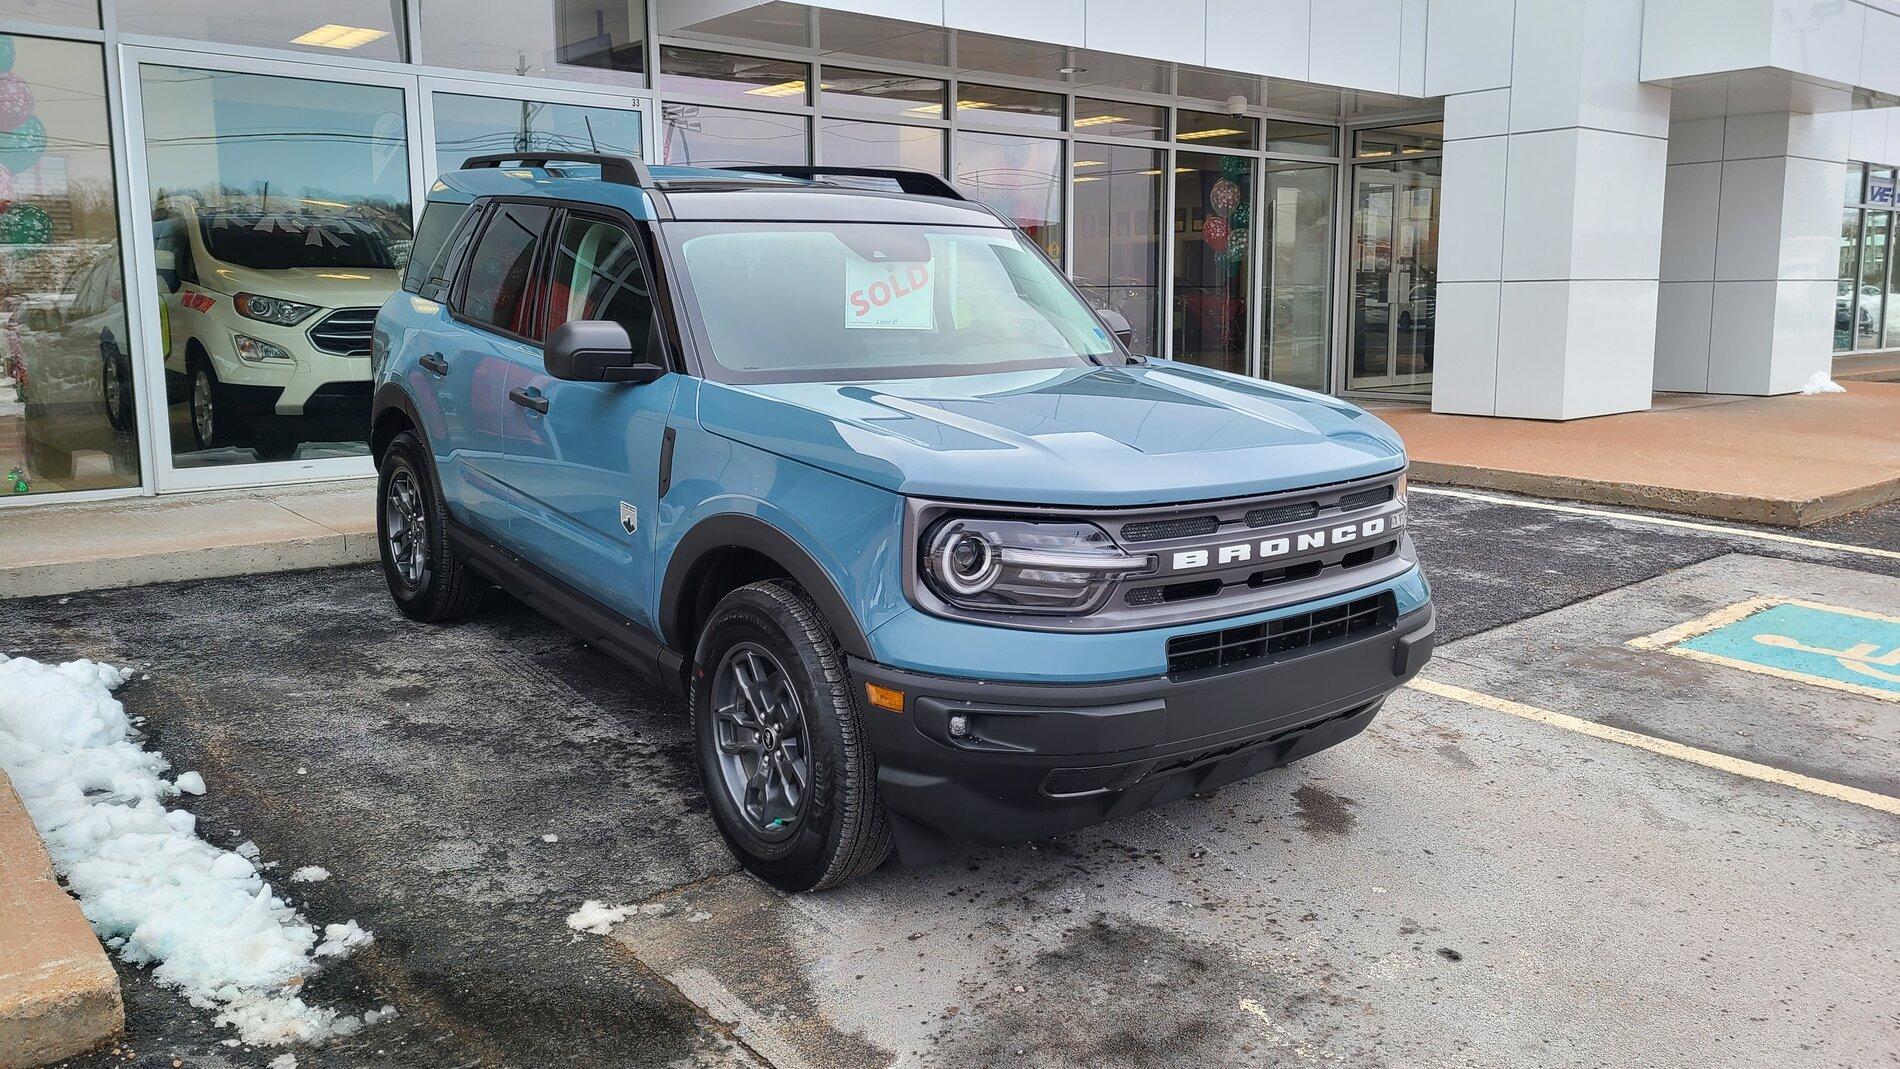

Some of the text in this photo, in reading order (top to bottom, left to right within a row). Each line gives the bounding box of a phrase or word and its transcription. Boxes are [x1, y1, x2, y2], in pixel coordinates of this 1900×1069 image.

[631, 98, 640, 107] 33
[849, 263, 929, 317] SOLD
[1173, 517, 1385, 570] BRONCO
